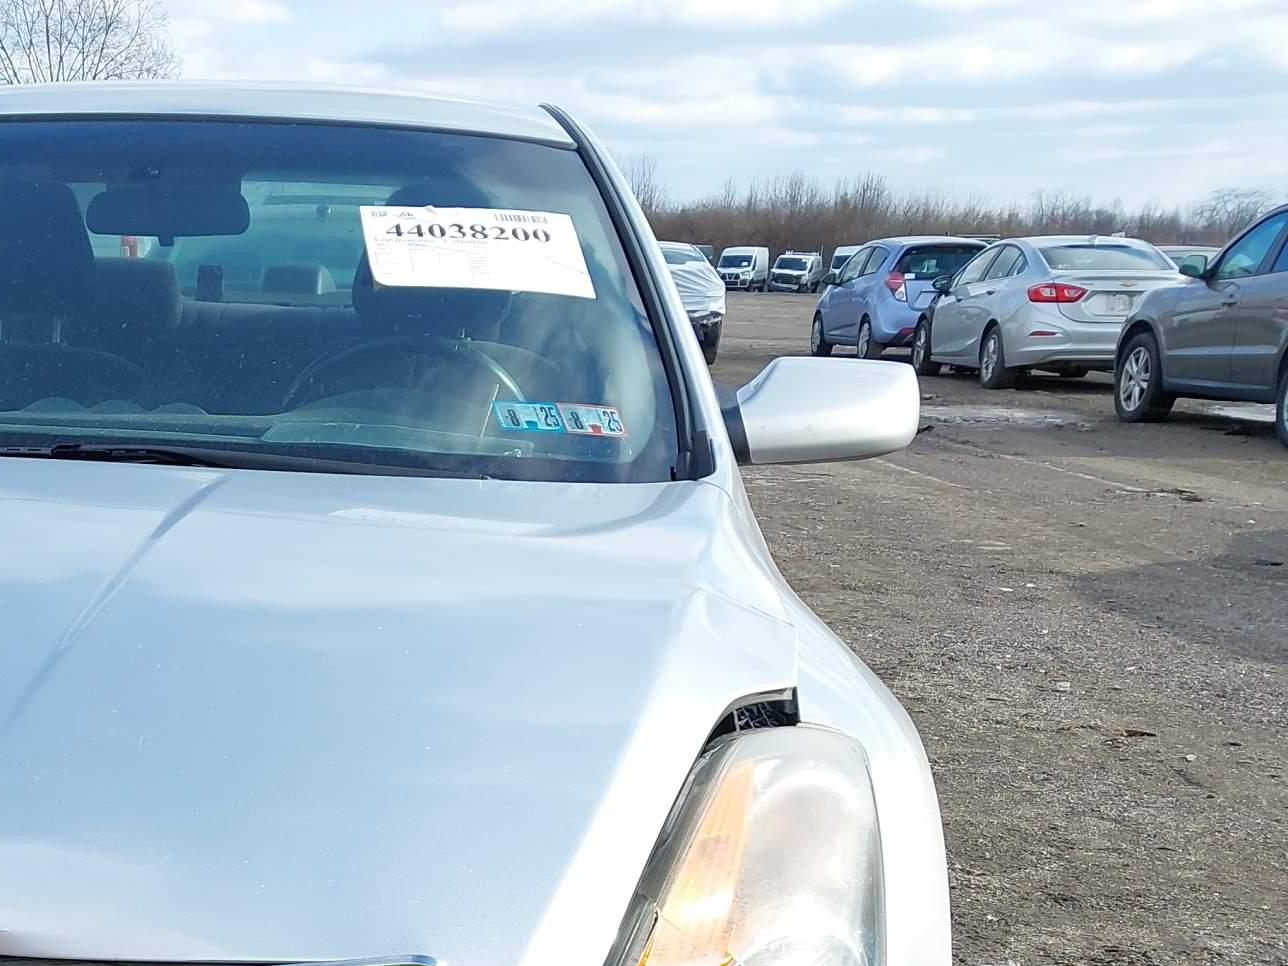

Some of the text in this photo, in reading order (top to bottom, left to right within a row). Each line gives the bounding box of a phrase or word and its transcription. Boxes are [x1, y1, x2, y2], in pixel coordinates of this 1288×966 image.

[386, 223, 551, 243] 44038200
[540, 406, 560, 427] 25
[603, 409, 623, 432] 25
